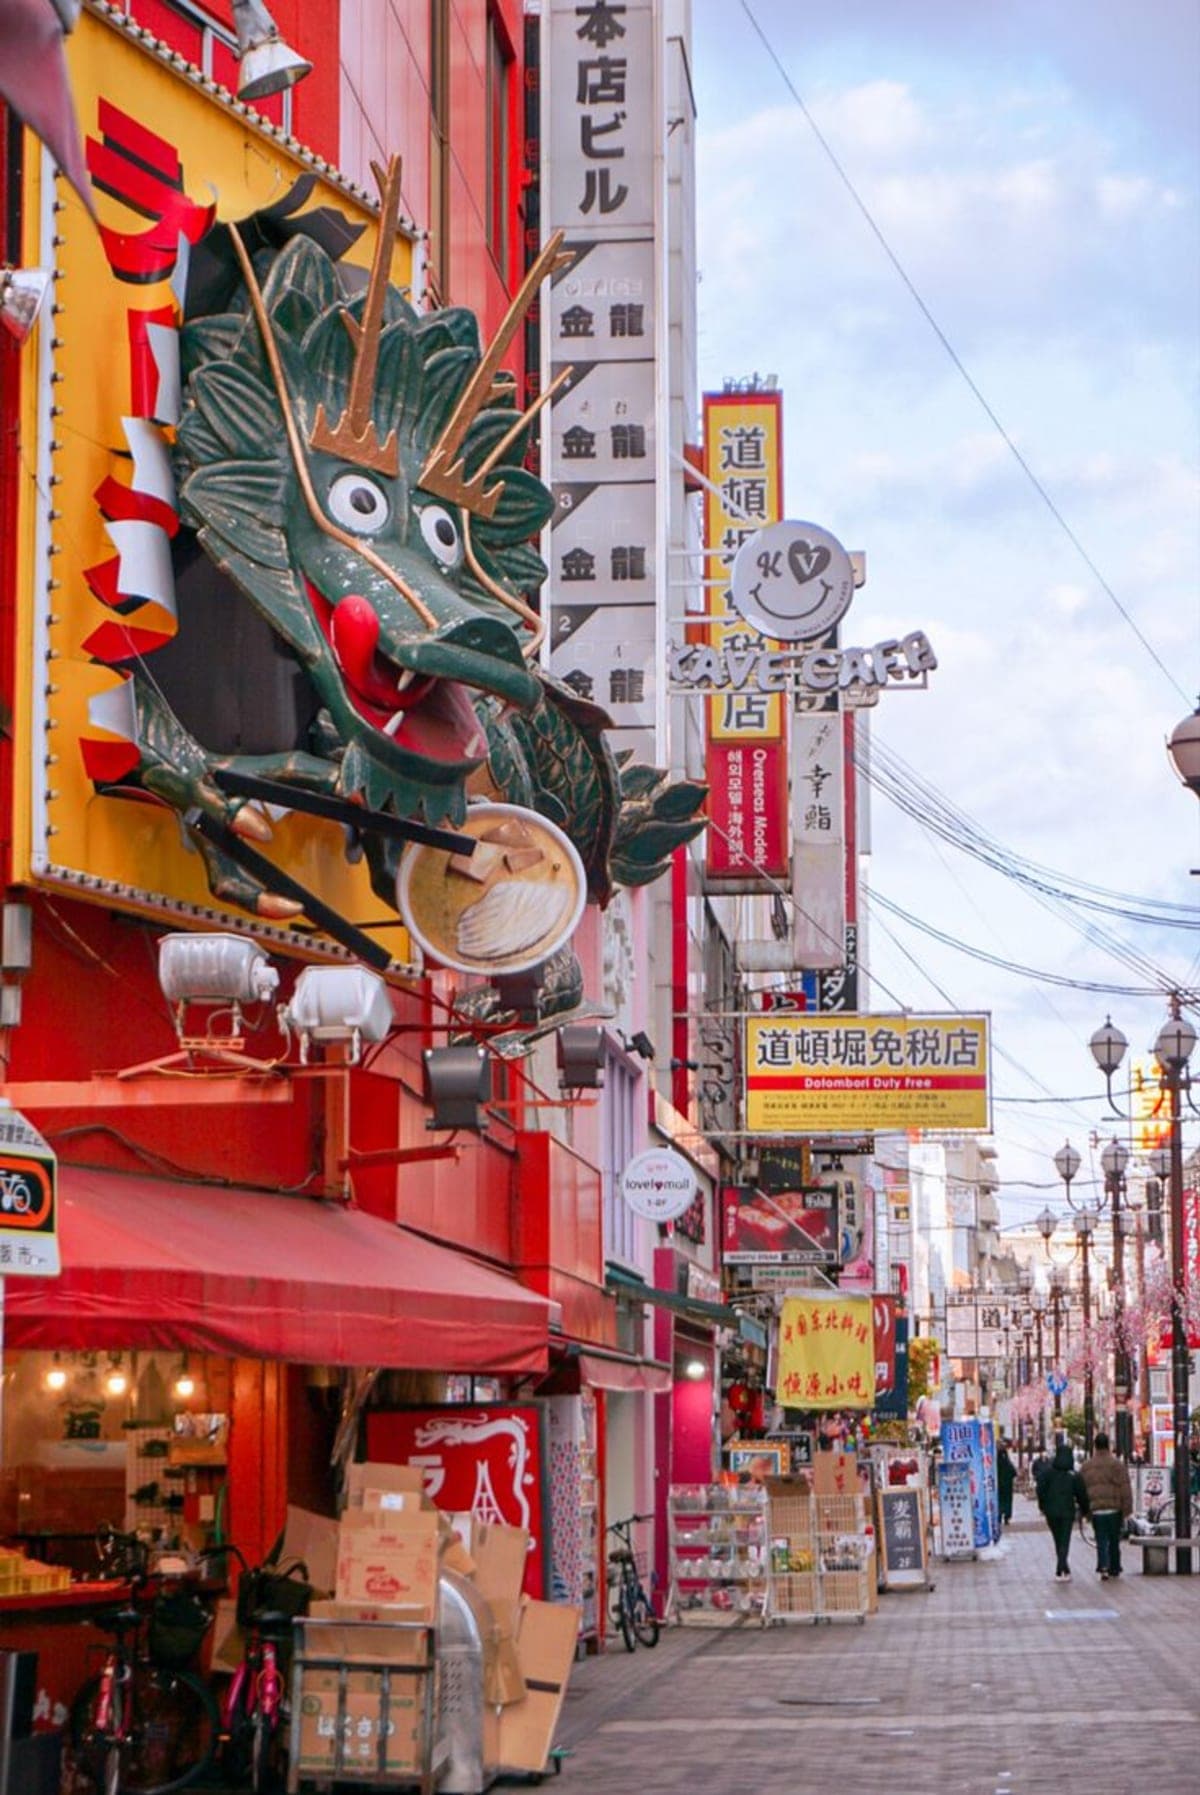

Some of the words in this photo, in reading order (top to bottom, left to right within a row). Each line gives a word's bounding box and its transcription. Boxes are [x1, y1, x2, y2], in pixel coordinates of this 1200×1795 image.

[575, 0, 628, 215] 本店ビル
[560, 303, 644, 338] 金龍
[561, 424, 646, 459] 金龍
[560, 493, 573, 509] 3
[561, 546, 646, 581] 金龍
[559, 616, 571, 632] 2
[752, 749, 768, 812] Overseas
[757, 1027, 979, 1067] 道頓堀免税店
[873, 1078, 901, 1090] Duty
[904, 1078, 932, 1088] Free
